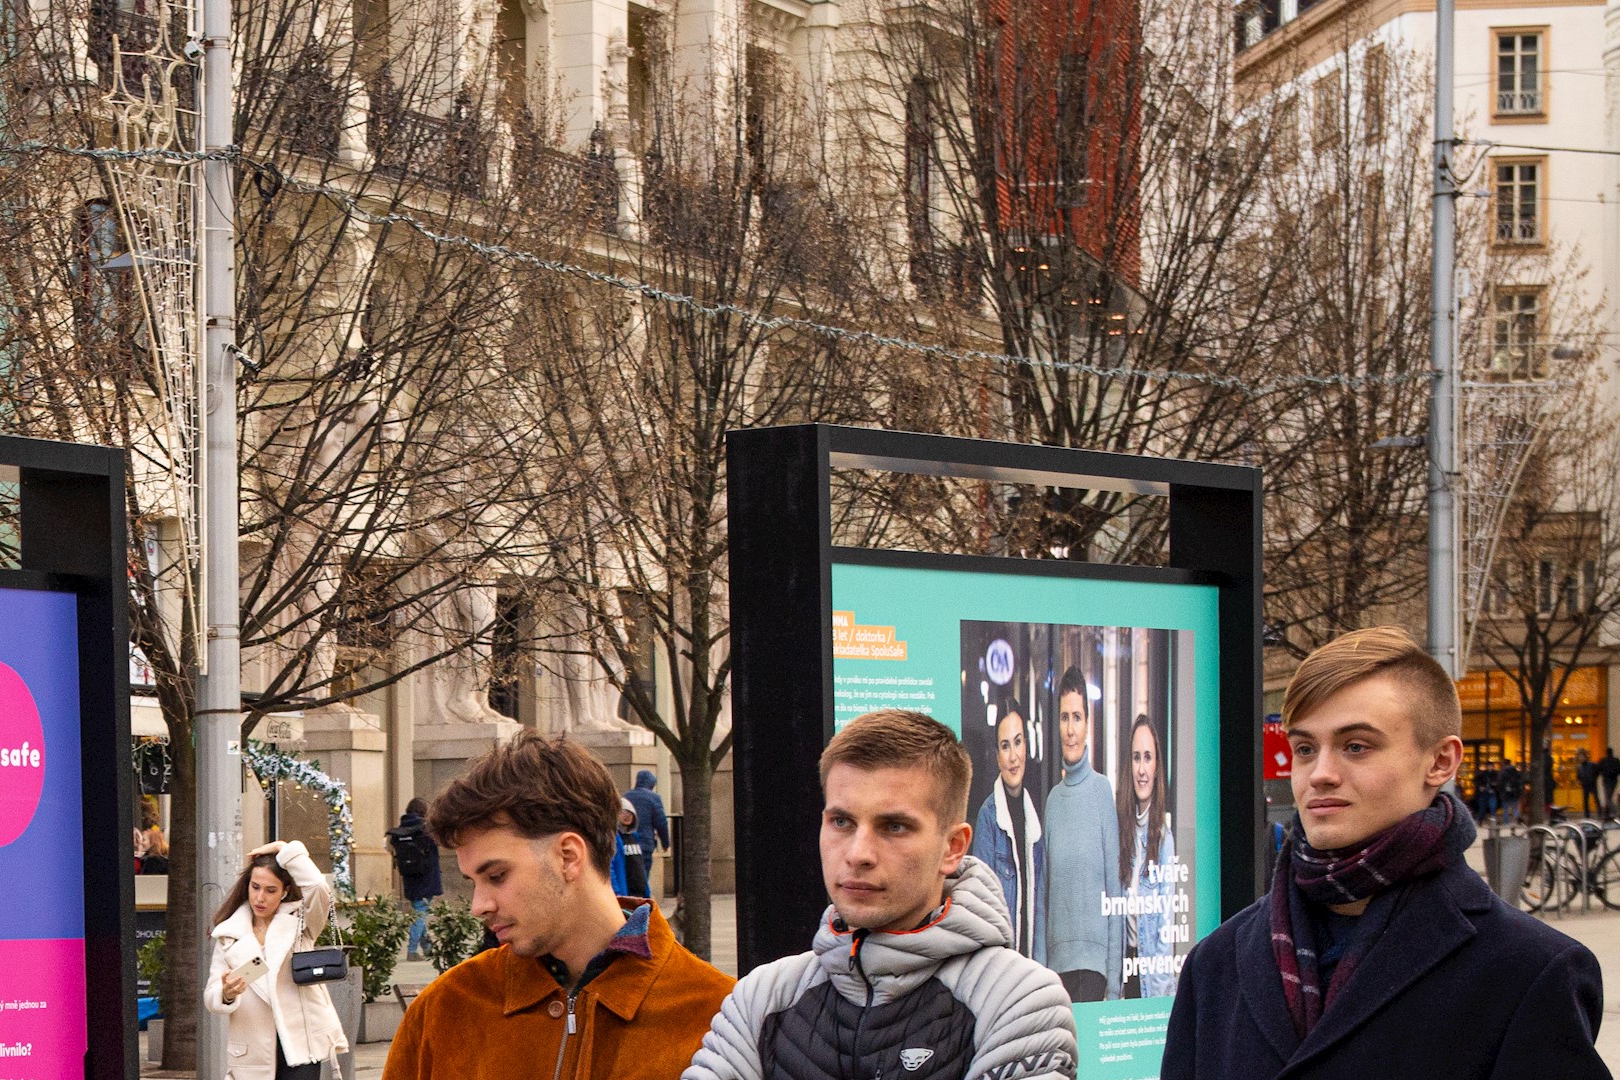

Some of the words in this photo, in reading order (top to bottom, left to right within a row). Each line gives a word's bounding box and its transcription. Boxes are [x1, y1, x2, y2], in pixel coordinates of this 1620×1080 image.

[856, 630, 886, 643] doktorka
[871, 646, 904, 659] SpoluSafe
[1147, 857, 1189, 882] tváře
[1100, 889, 1189, 919] brněnských
[1159, 914, 1189, 944] dnů
